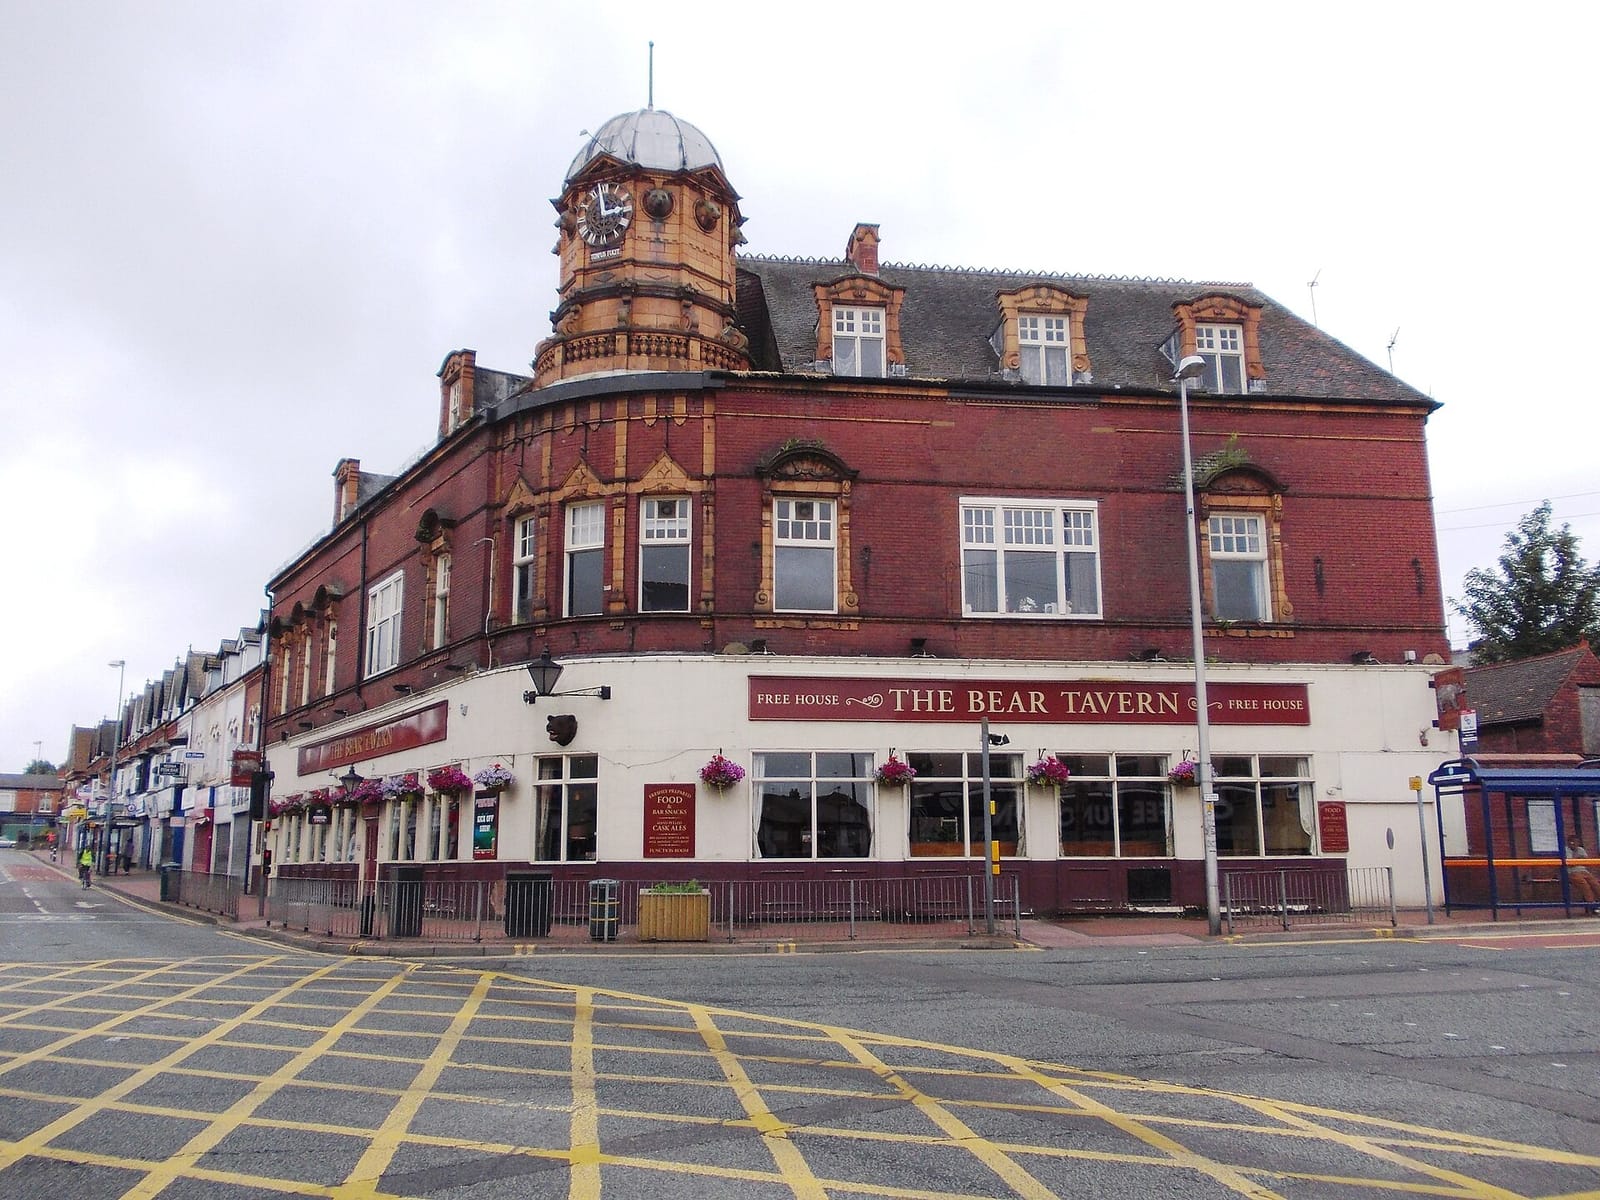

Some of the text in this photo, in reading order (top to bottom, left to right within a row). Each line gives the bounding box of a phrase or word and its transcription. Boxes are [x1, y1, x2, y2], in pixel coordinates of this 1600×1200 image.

[757, 689, 1304, 714] FREE HOUSE THE BEAR TAVERN FREE HOUSE
[345, 737, 363, 757] BEAR
[364, 728, 393, 751] TAVERN
[657, 796, 683, 804] FOOD
